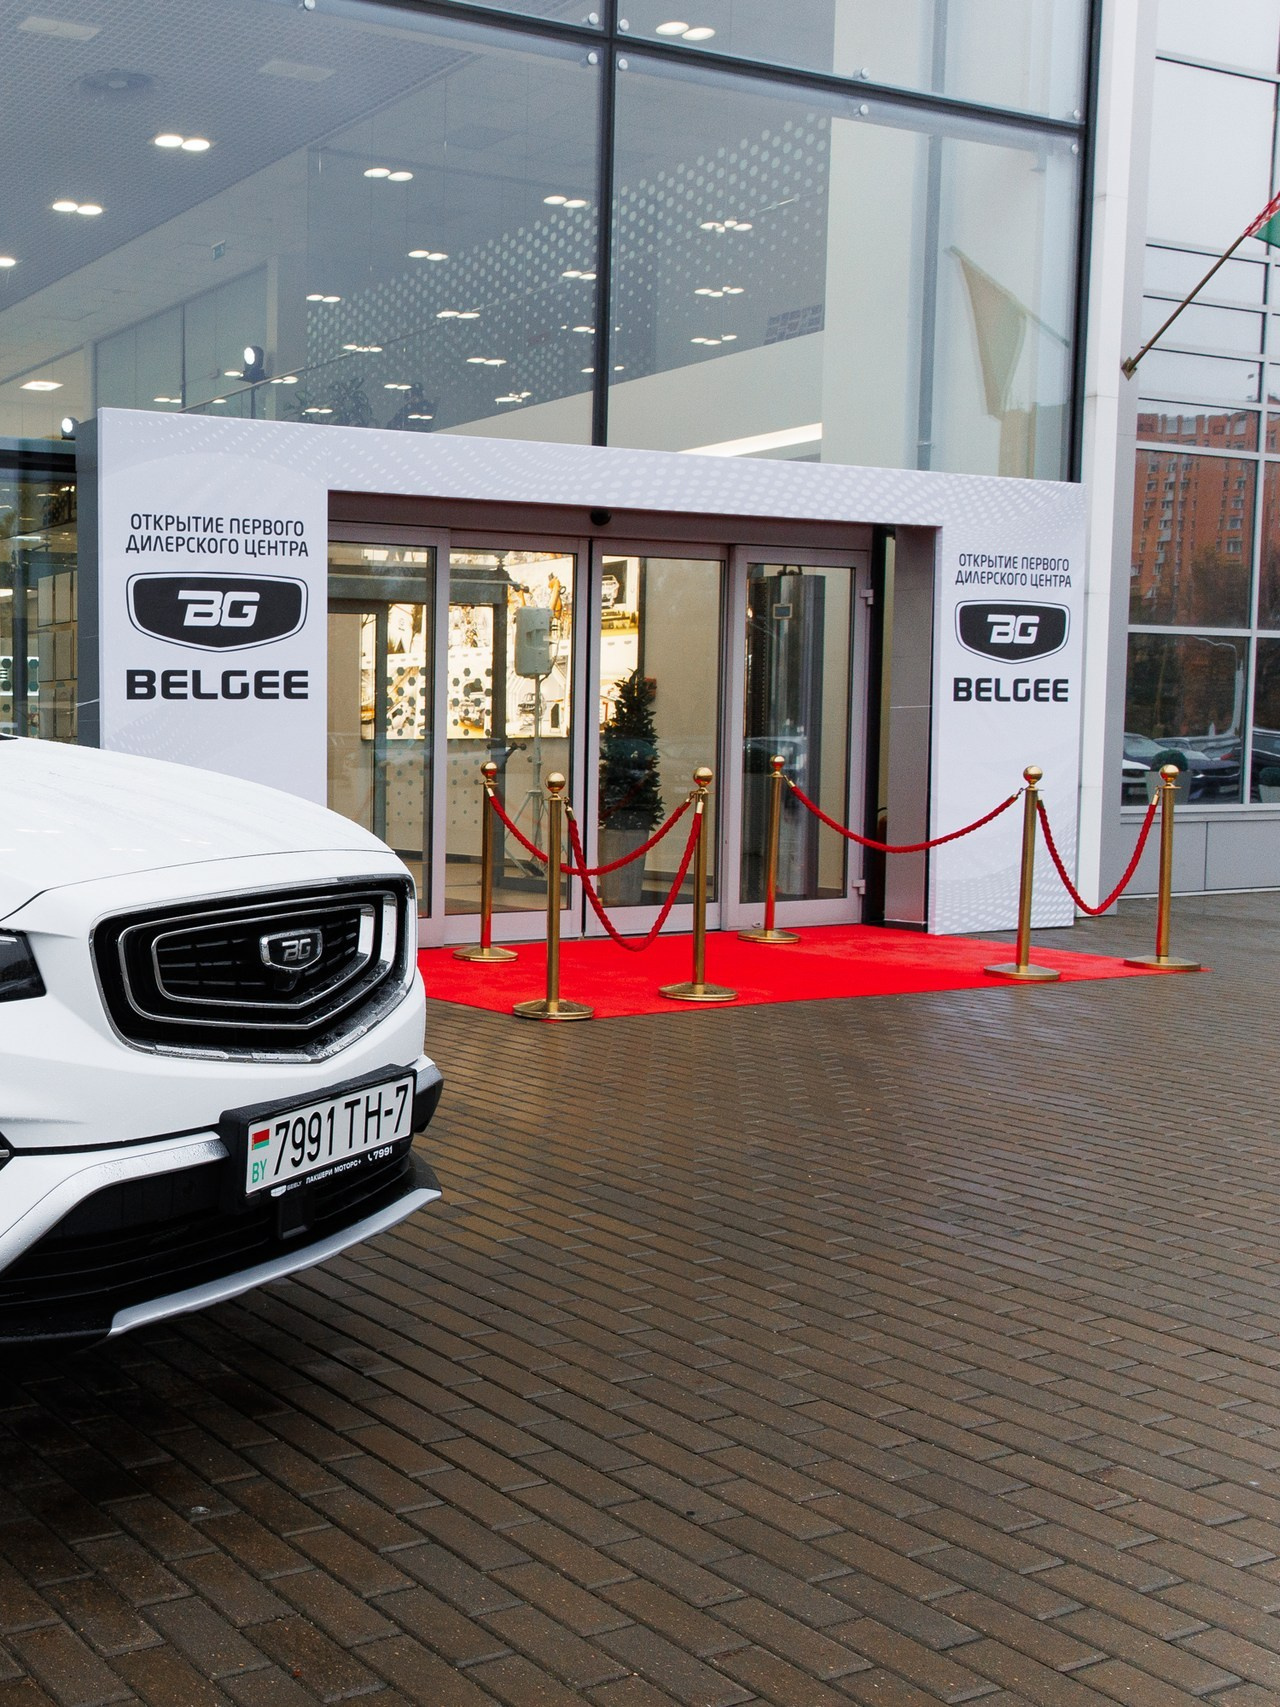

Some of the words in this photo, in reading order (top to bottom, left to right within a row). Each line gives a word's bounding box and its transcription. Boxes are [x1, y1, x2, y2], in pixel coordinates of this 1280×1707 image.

[130, 513, 224, 534] ОТКРЫТИЕ
[229, 517, 304, 537] ПЕРВОГО
[125, 534, 239, 555] ДИЛЕРСКОГО
[244, 538, 309, 558] ЦЕНТРА
[958, 553, 1019, 570] ОТКРЫТИЕ
[1021, 556, 1070, 572] ПЕРВОГО
[955, 570, 1028, 586] ДИЛЕРСКОГО
[1030, 573, 1072, 589] ЦЕНТРА
[177, 589, 261, 627] BG
[986, 614, 1040, 644] BG
[125, 669, 309, 700] BELGEE
[953, 677, 1069, 702] BELGEE
[273, 1106, 335, 1176] 7991
[344, 1083, 409, 1149] TH-7
[373, 1145, 393, 1160] 7991
[251, 1158, 267, 1183] BY
[305, 1168, 333, 1185] ЛАКШЕРИ
